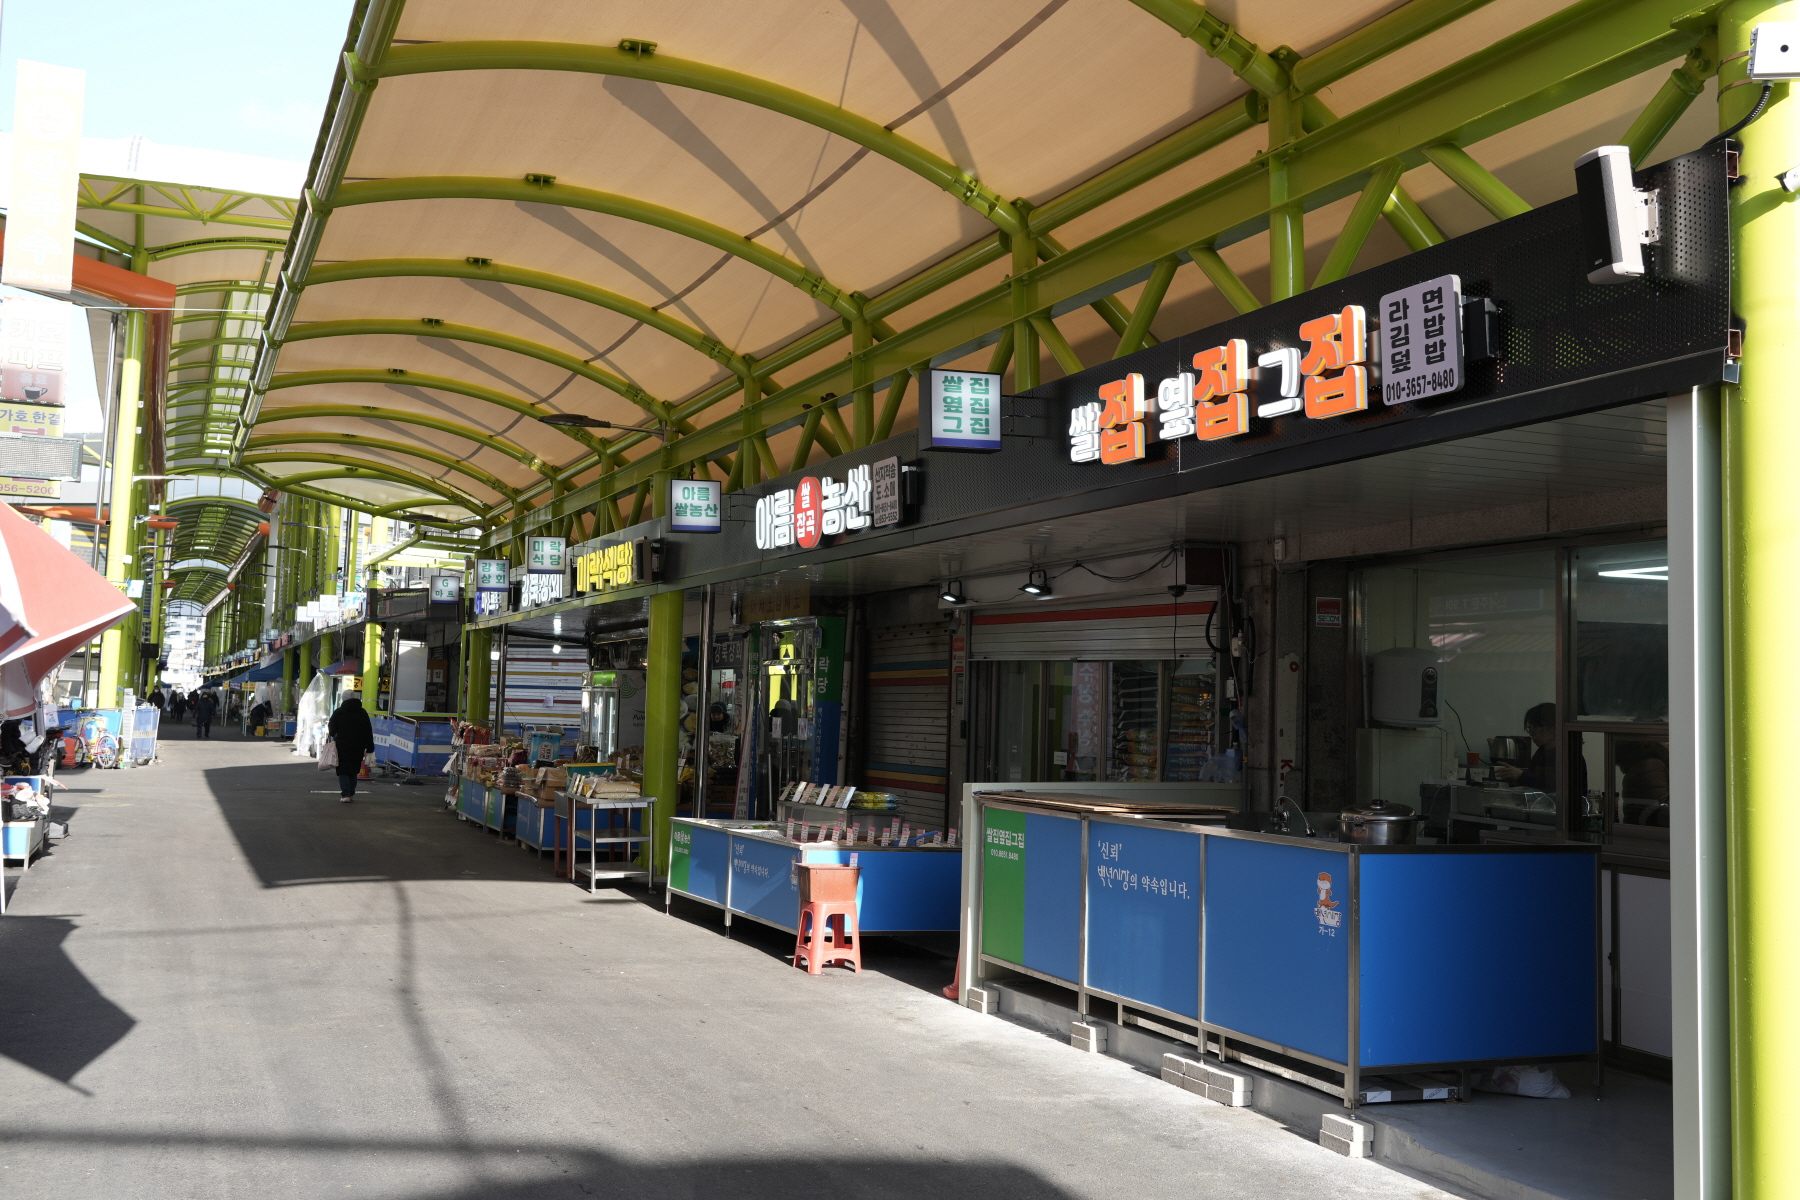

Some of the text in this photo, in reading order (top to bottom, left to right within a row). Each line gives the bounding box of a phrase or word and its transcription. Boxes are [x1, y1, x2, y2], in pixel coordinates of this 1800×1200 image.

[1385, 368, 1455, 404] 010-3657-8480
[682, 487, 711, 502] 아름
[674, 502, 718, 518] 쌀농산
[755, 488, 796, 549] 아름
[821, 464, 872, 535] 농산
[533, 541, 562, 553] 미락
[481, 562, 506, 573] 강북
[533, 554, 562, 566] 식당
[577, 541, 633, 592] 미락식당
[480, 573, 506, 585] 상회
[522, 573, 563, 607] 강북상회
[714, 643, 744, 663] 강북상회
[986, 827, 1025, 848] 쌀집옆집그집
[1097, 865, 1190, 900] 백년시장의 약속입니다.
[1318, 926, 1335, 937] 가-12
